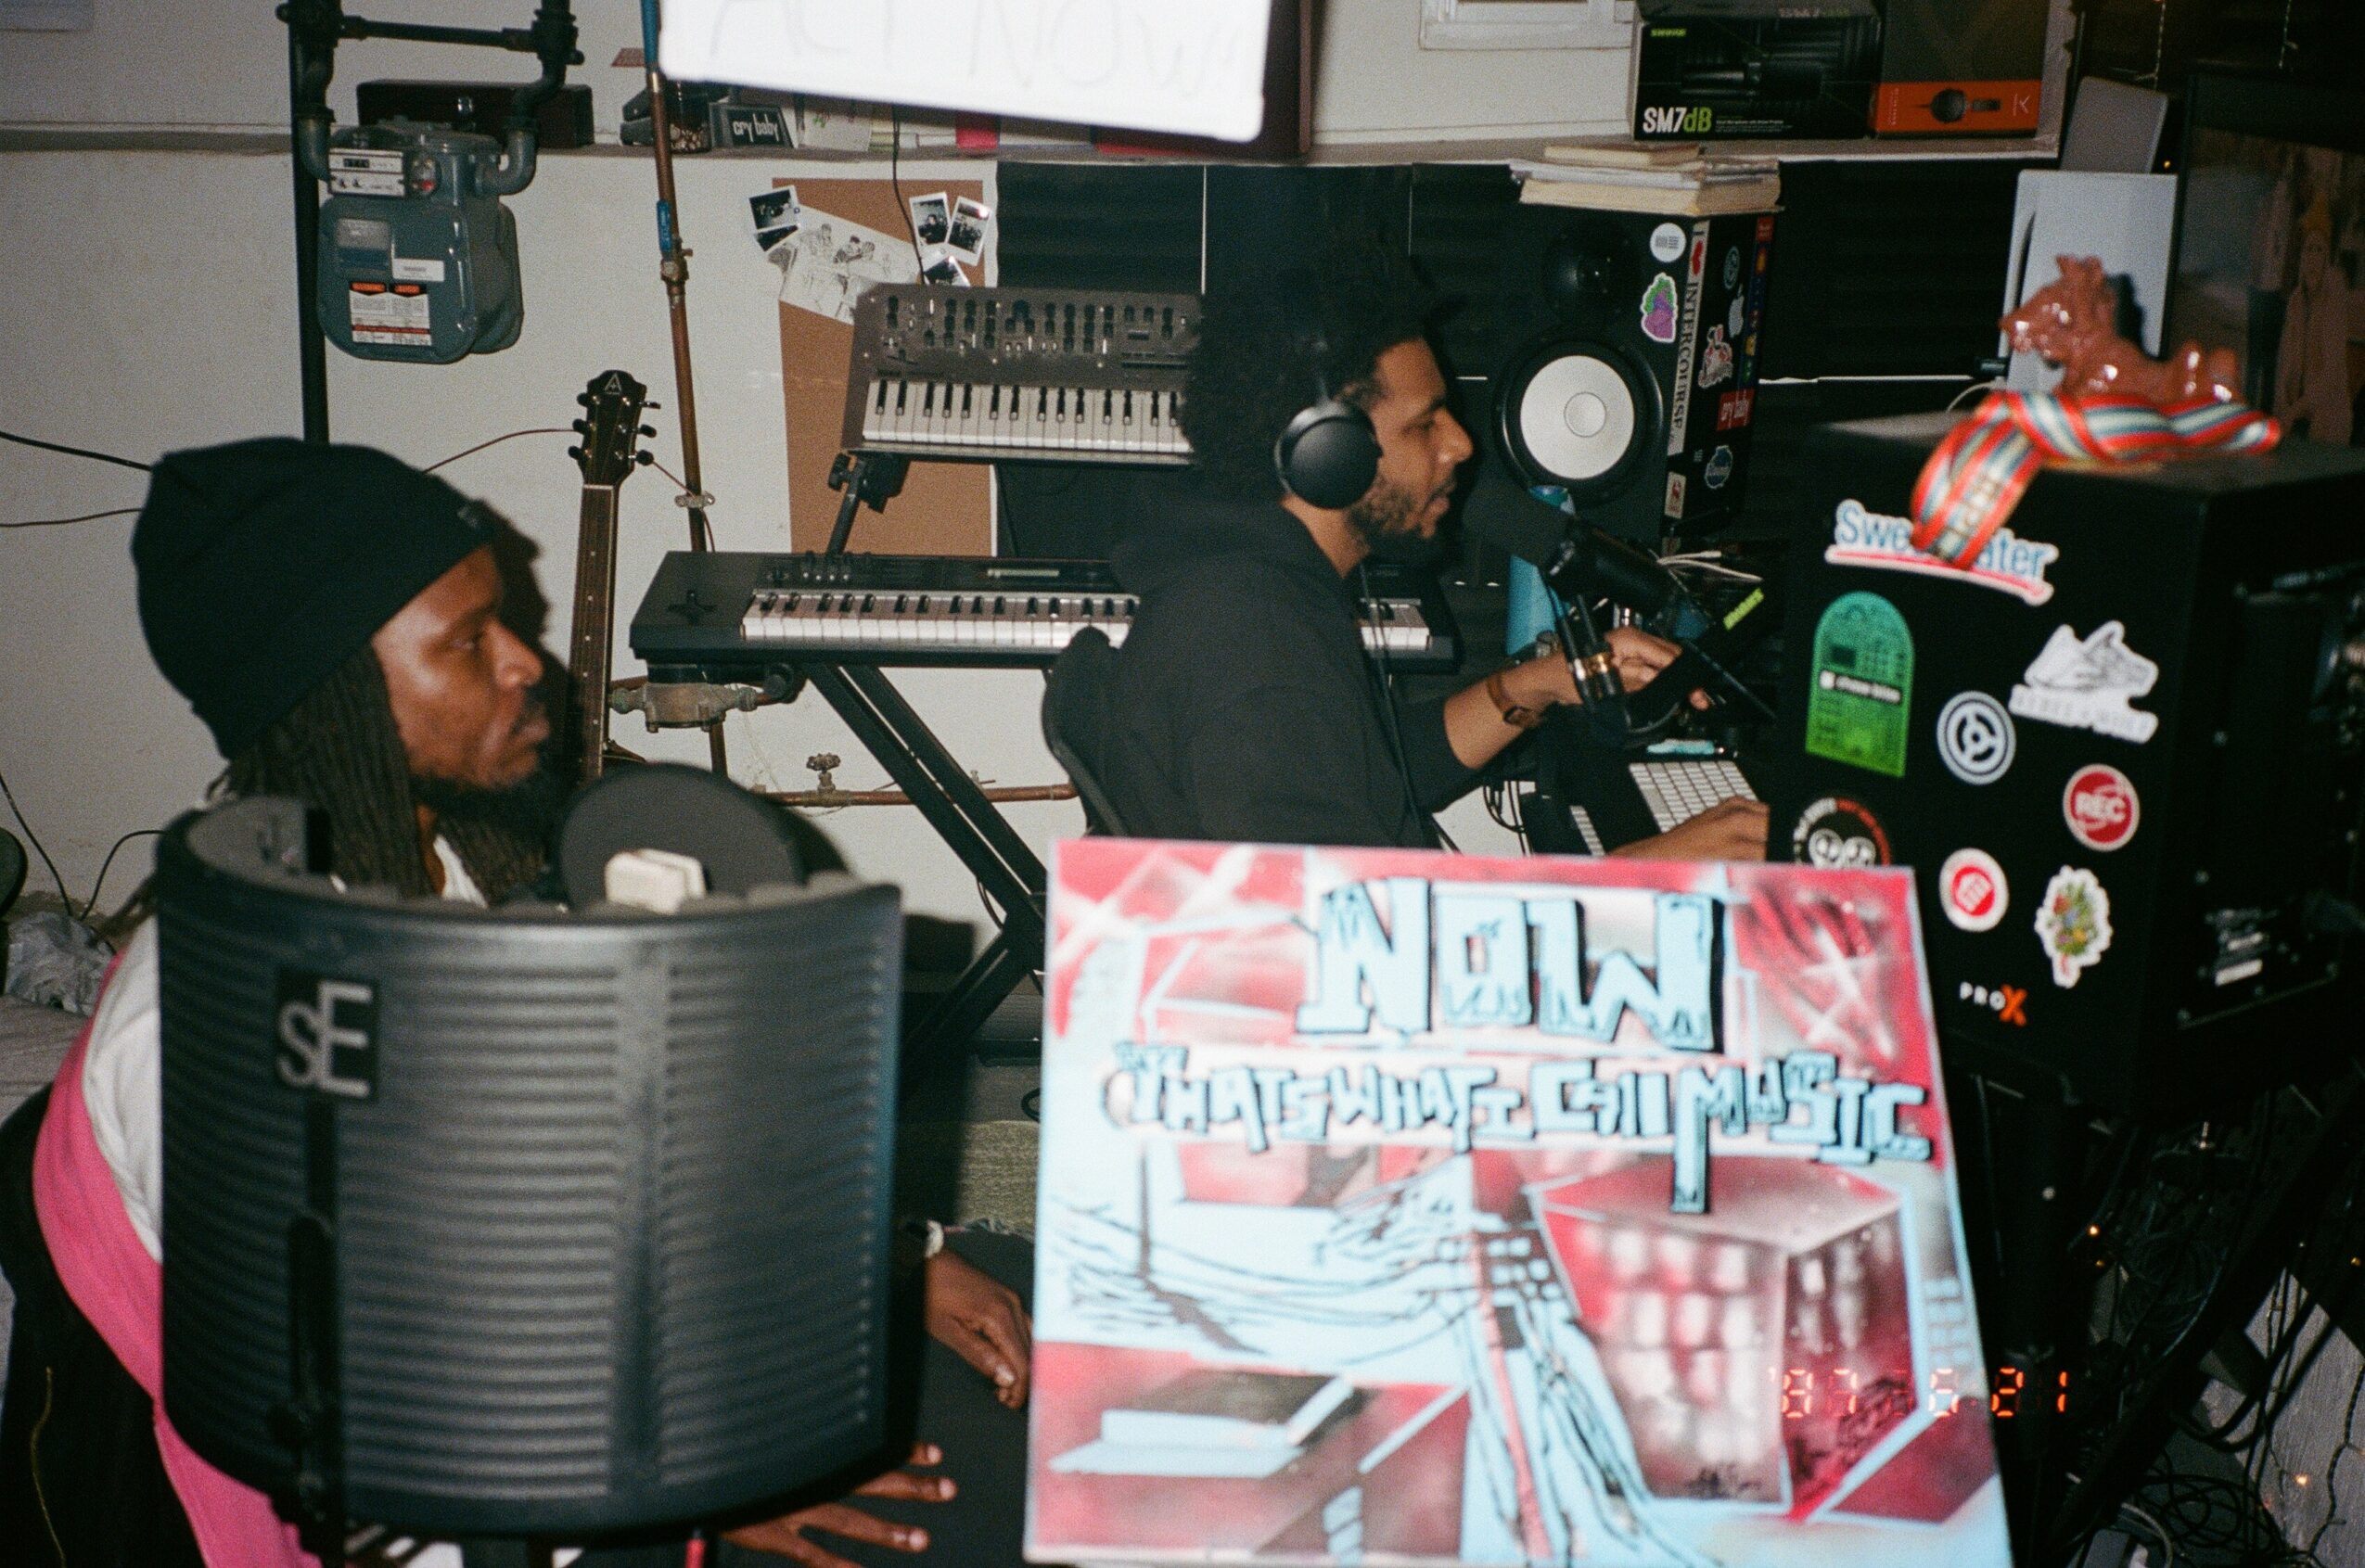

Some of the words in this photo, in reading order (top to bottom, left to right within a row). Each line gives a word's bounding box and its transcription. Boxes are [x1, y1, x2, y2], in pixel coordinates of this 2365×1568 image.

[732, 121, 753, 142] cry
[752, 113, 779, 141] baby
[1643, 107, 1712, 134] SM7dB
[1839, 505, 2046, 579] Sweater
[1297, 876, 1727, 1055] NOW
[1327, 1064, 1499, 1154] WHAT
[1673, 1050, 1933, 1213] MUSIC
